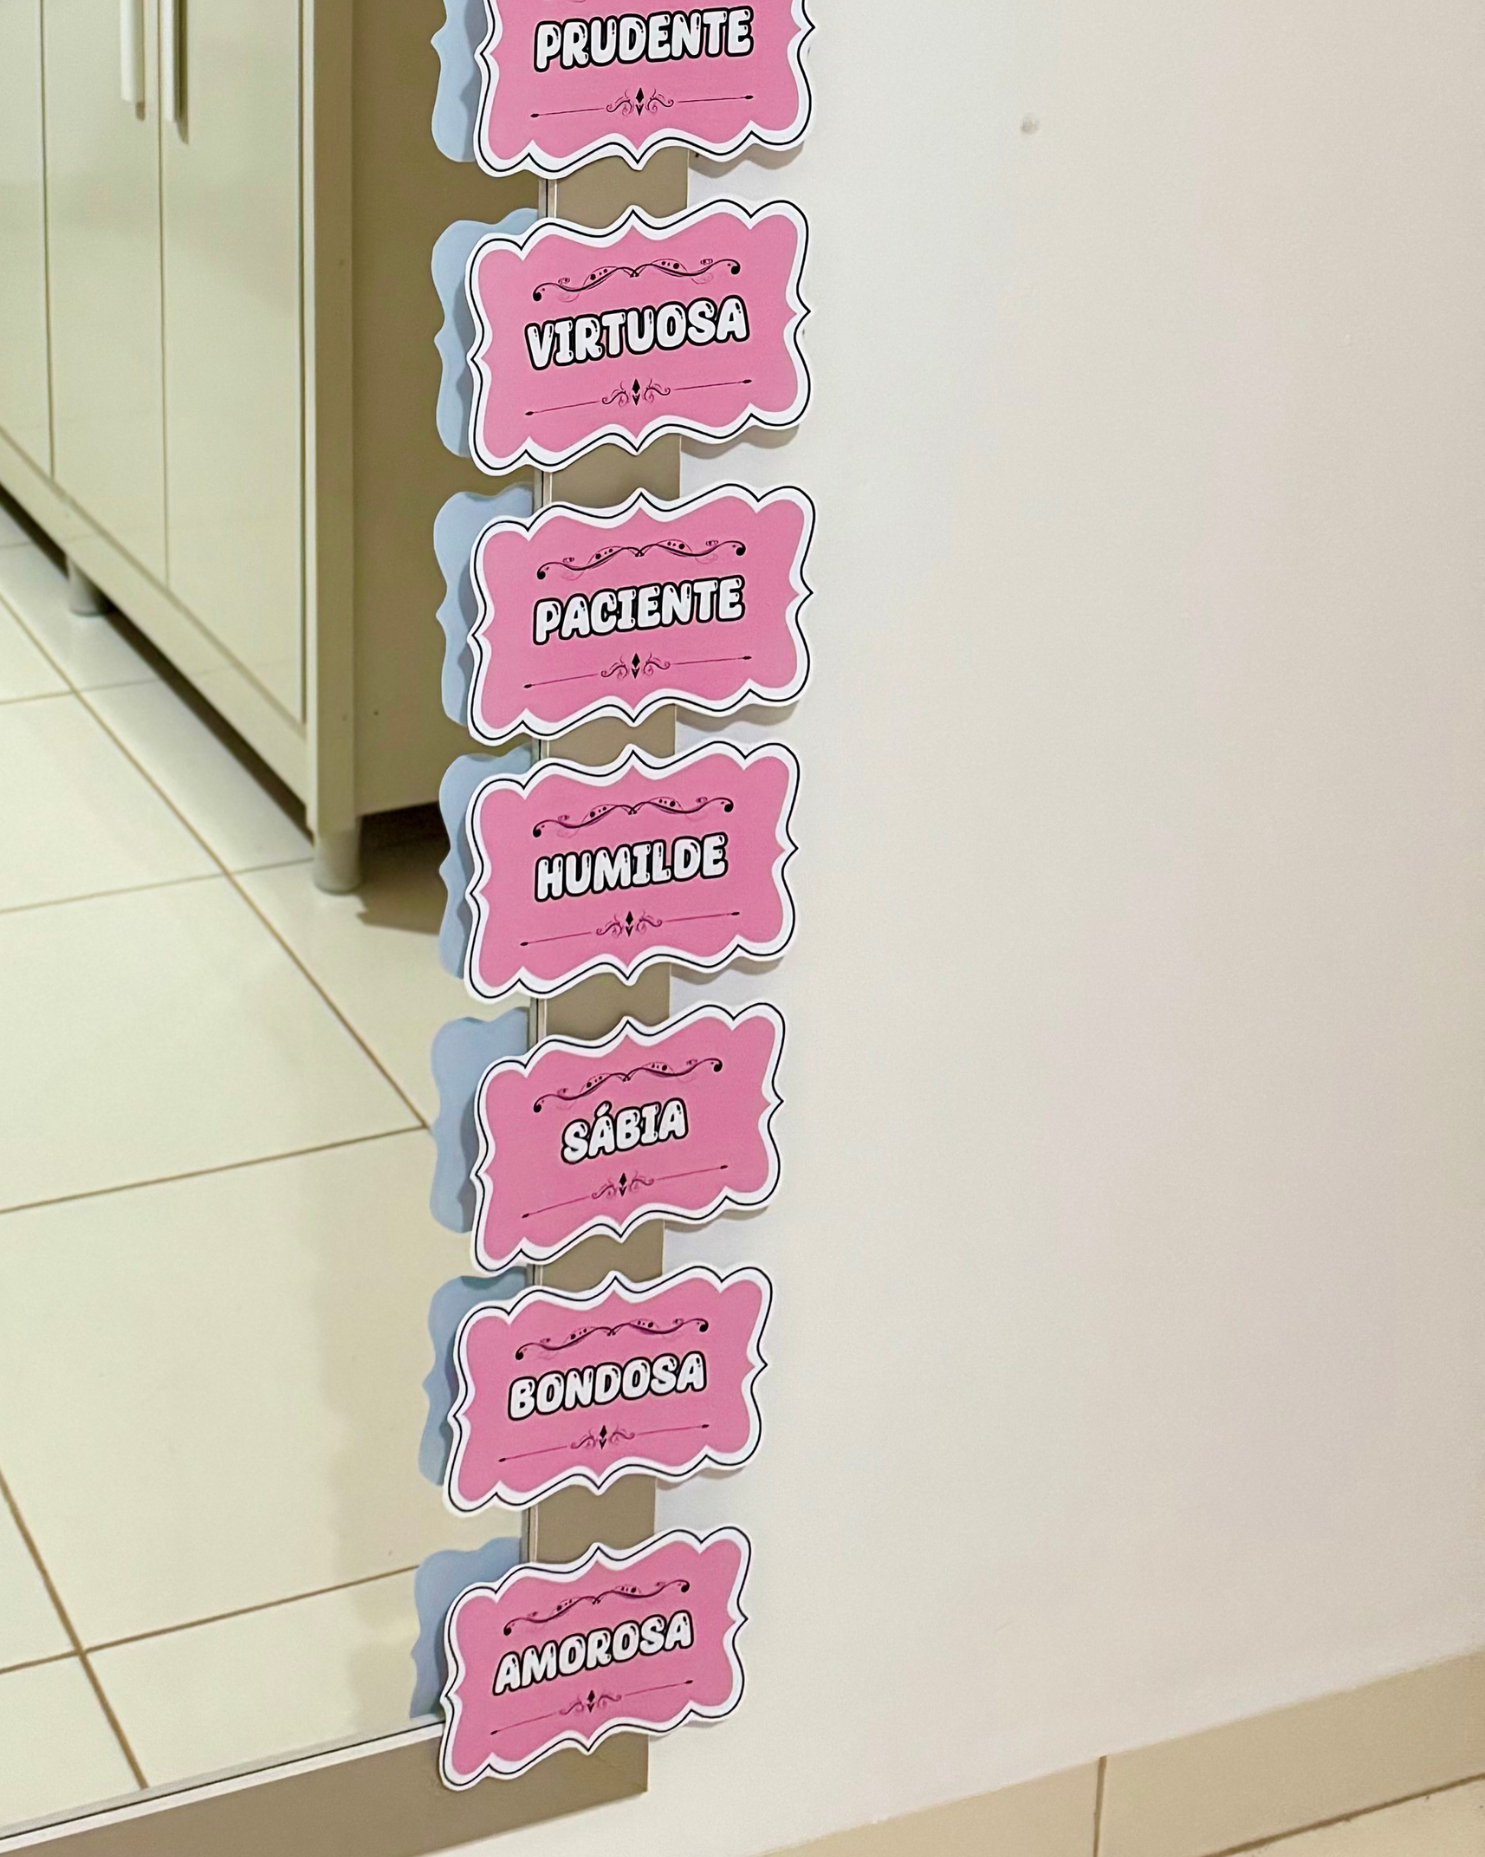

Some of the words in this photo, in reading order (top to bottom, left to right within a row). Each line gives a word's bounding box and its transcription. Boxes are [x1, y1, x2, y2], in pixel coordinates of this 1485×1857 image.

[534, 6, 754, 72] PRUDENTE
[525, 295, 749, 370] VIRTUOSA
[533, 575, 745, 645] PACIENTE
[535, 832, 728, 902] HUMILDE
[561, 1098, 688, 1164] SÁBIA
[508, 1351, 707, 1421] BONDOSA
[493, 1610, 694, 1696] AMOROSA
